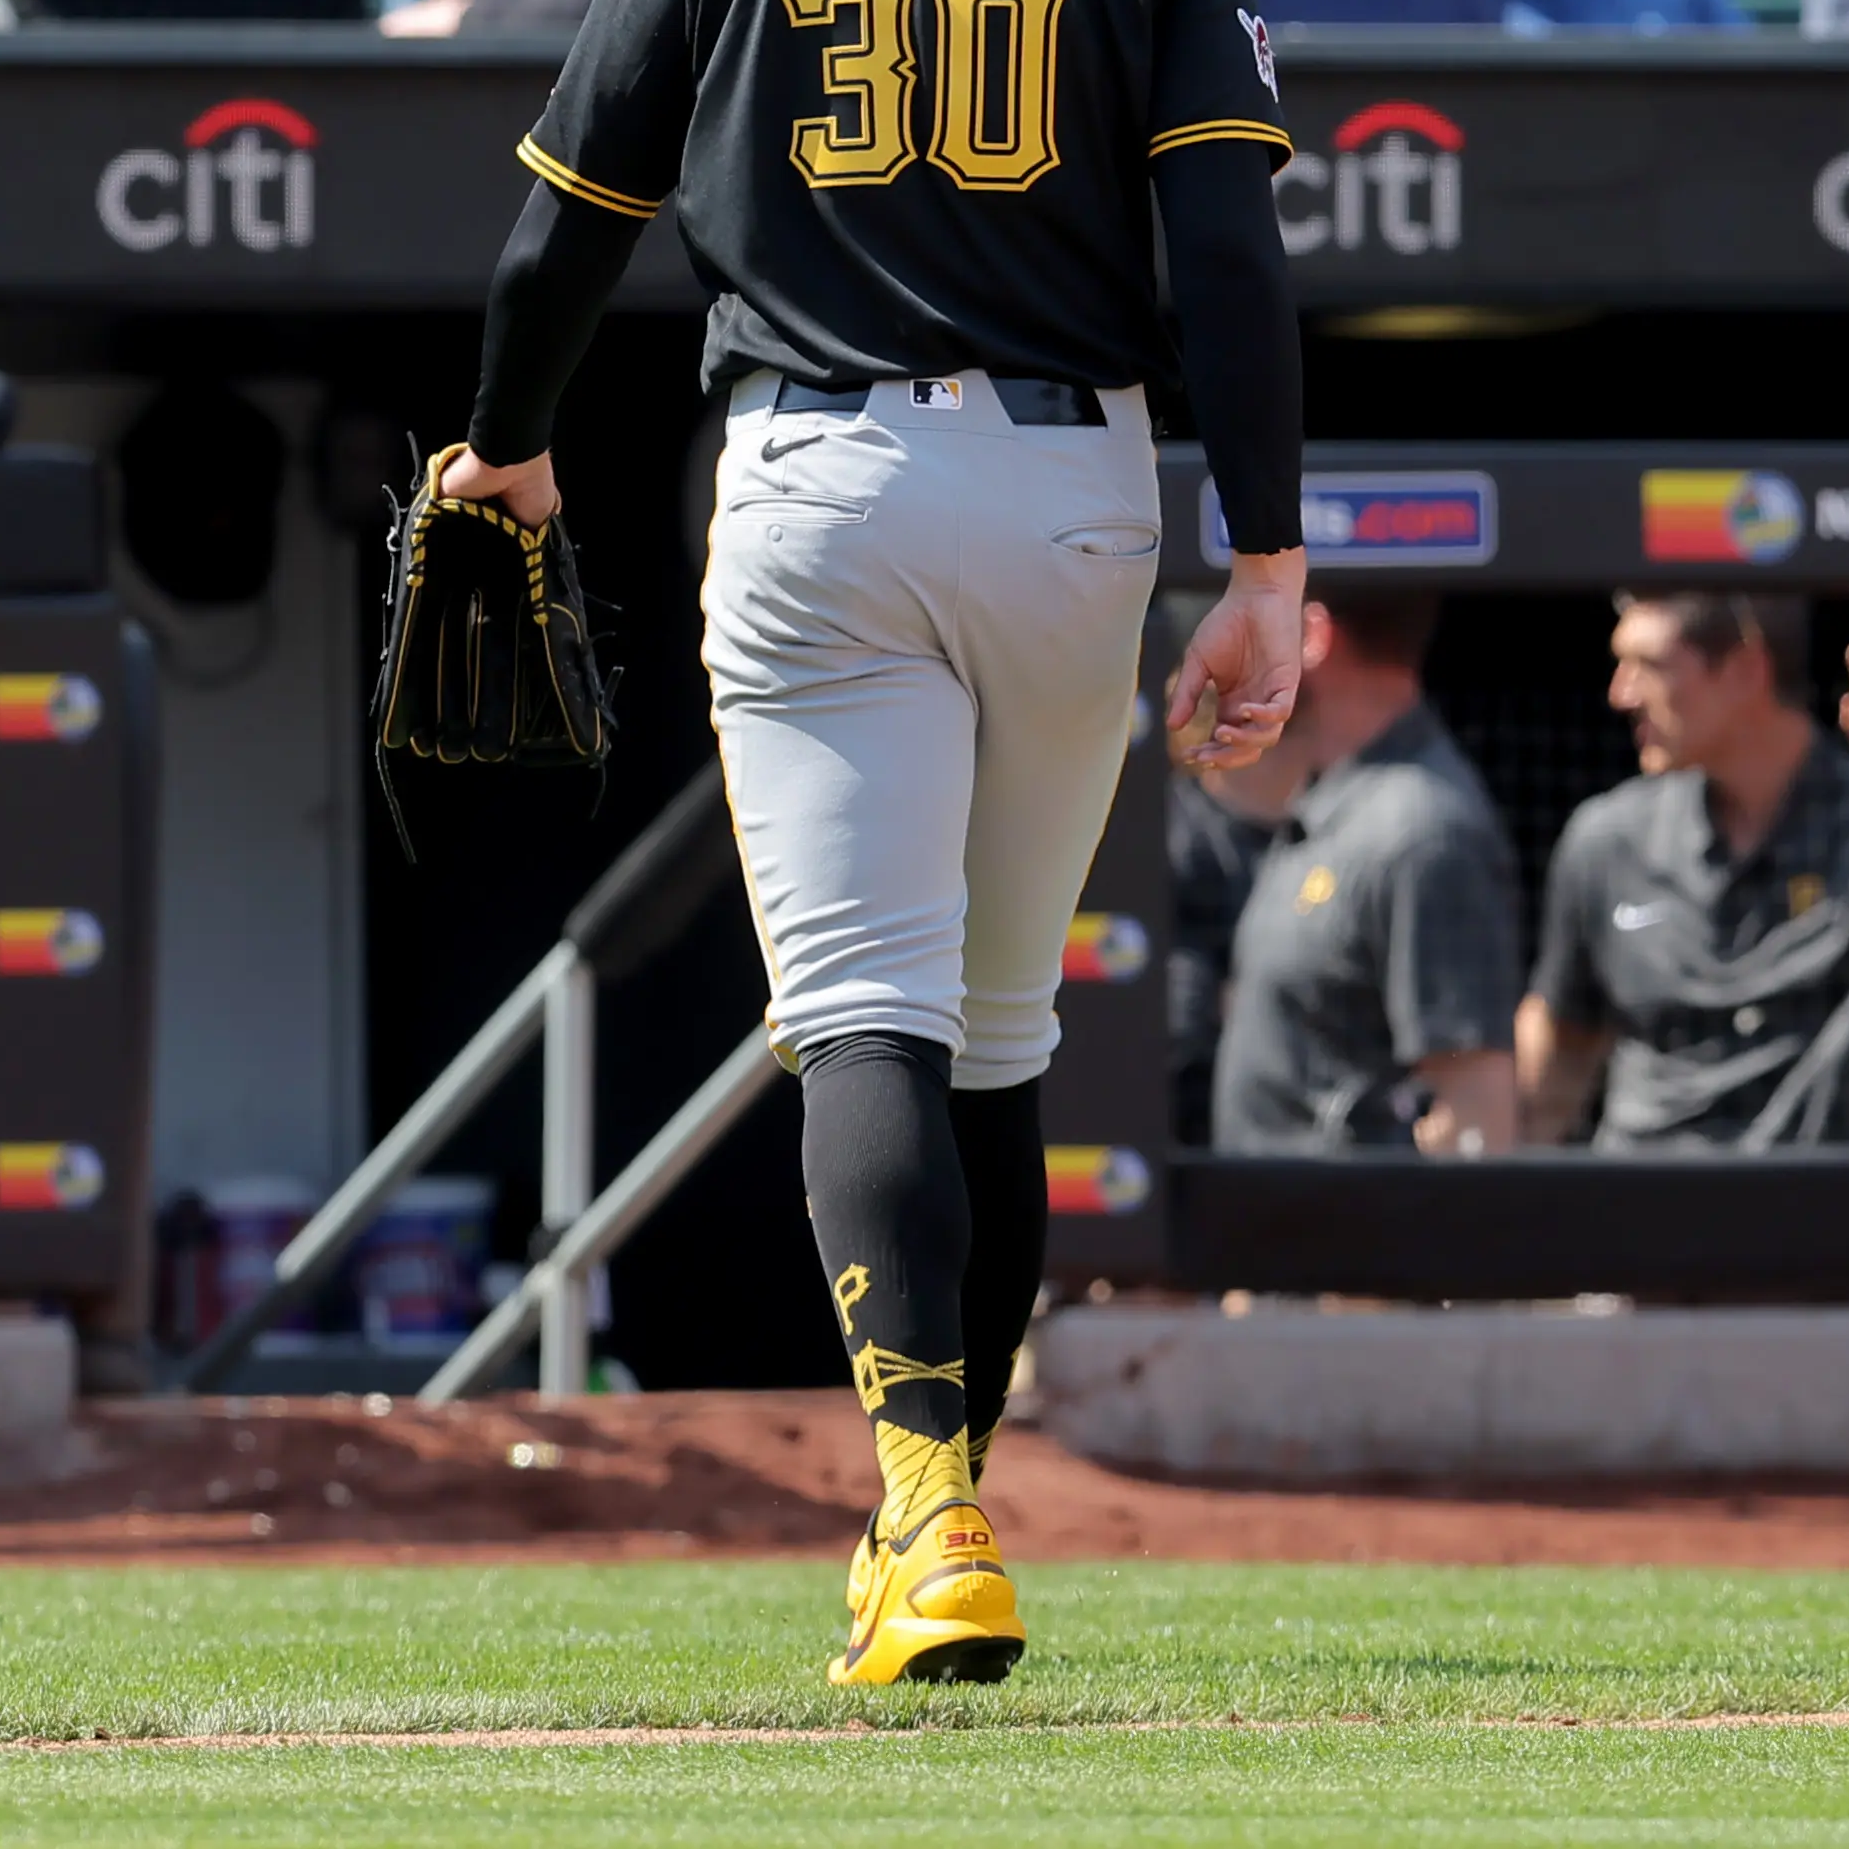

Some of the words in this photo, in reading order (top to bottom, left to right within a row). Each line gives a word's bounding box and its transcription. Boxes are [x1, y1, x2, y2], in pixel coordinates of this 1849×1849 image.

[96, 128, 317, 251] citi
[834, 1262, 870, 1336] P
[945, 1531, 989, 1549] 30
